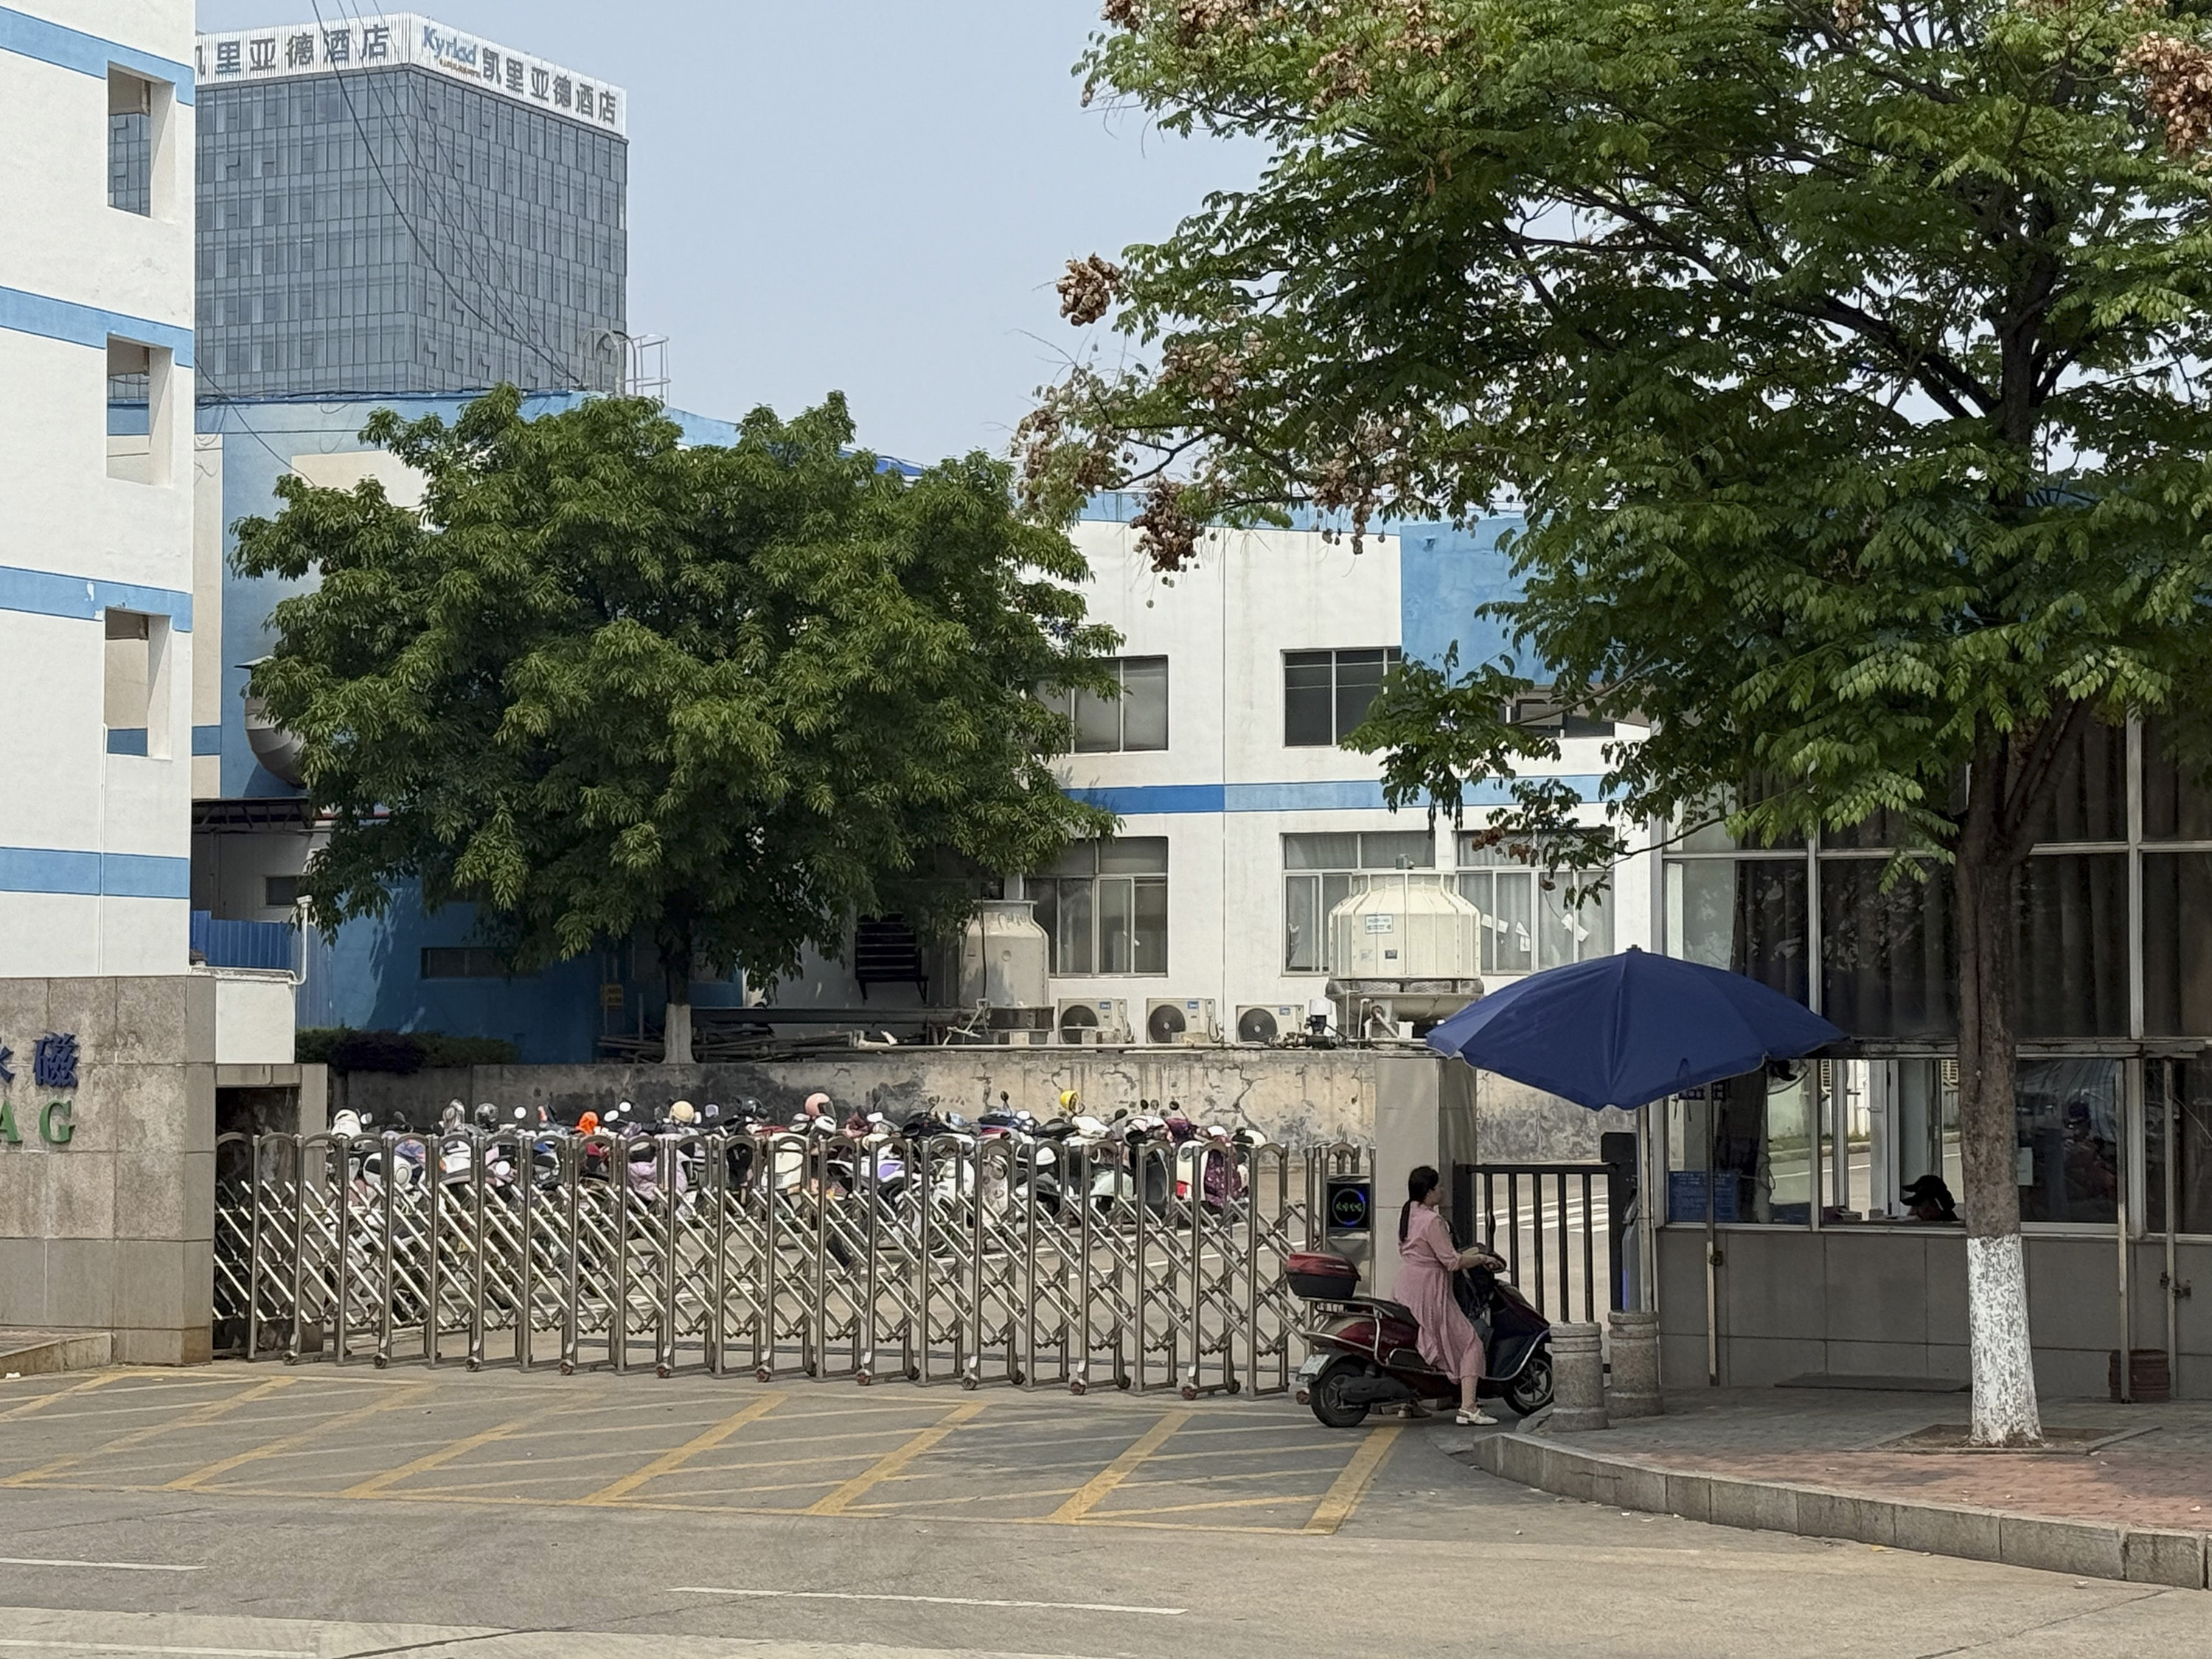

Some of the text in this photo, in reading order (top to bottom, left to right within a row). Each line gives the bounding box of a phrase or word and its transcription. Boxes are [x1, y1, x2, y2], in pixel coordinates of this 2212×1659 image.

[195, 24, 389, 77] 里亚德酒店
[424, 25, 477, 66] Kyriad
[482, 46, 616, 125] 凯里亚德酒店
